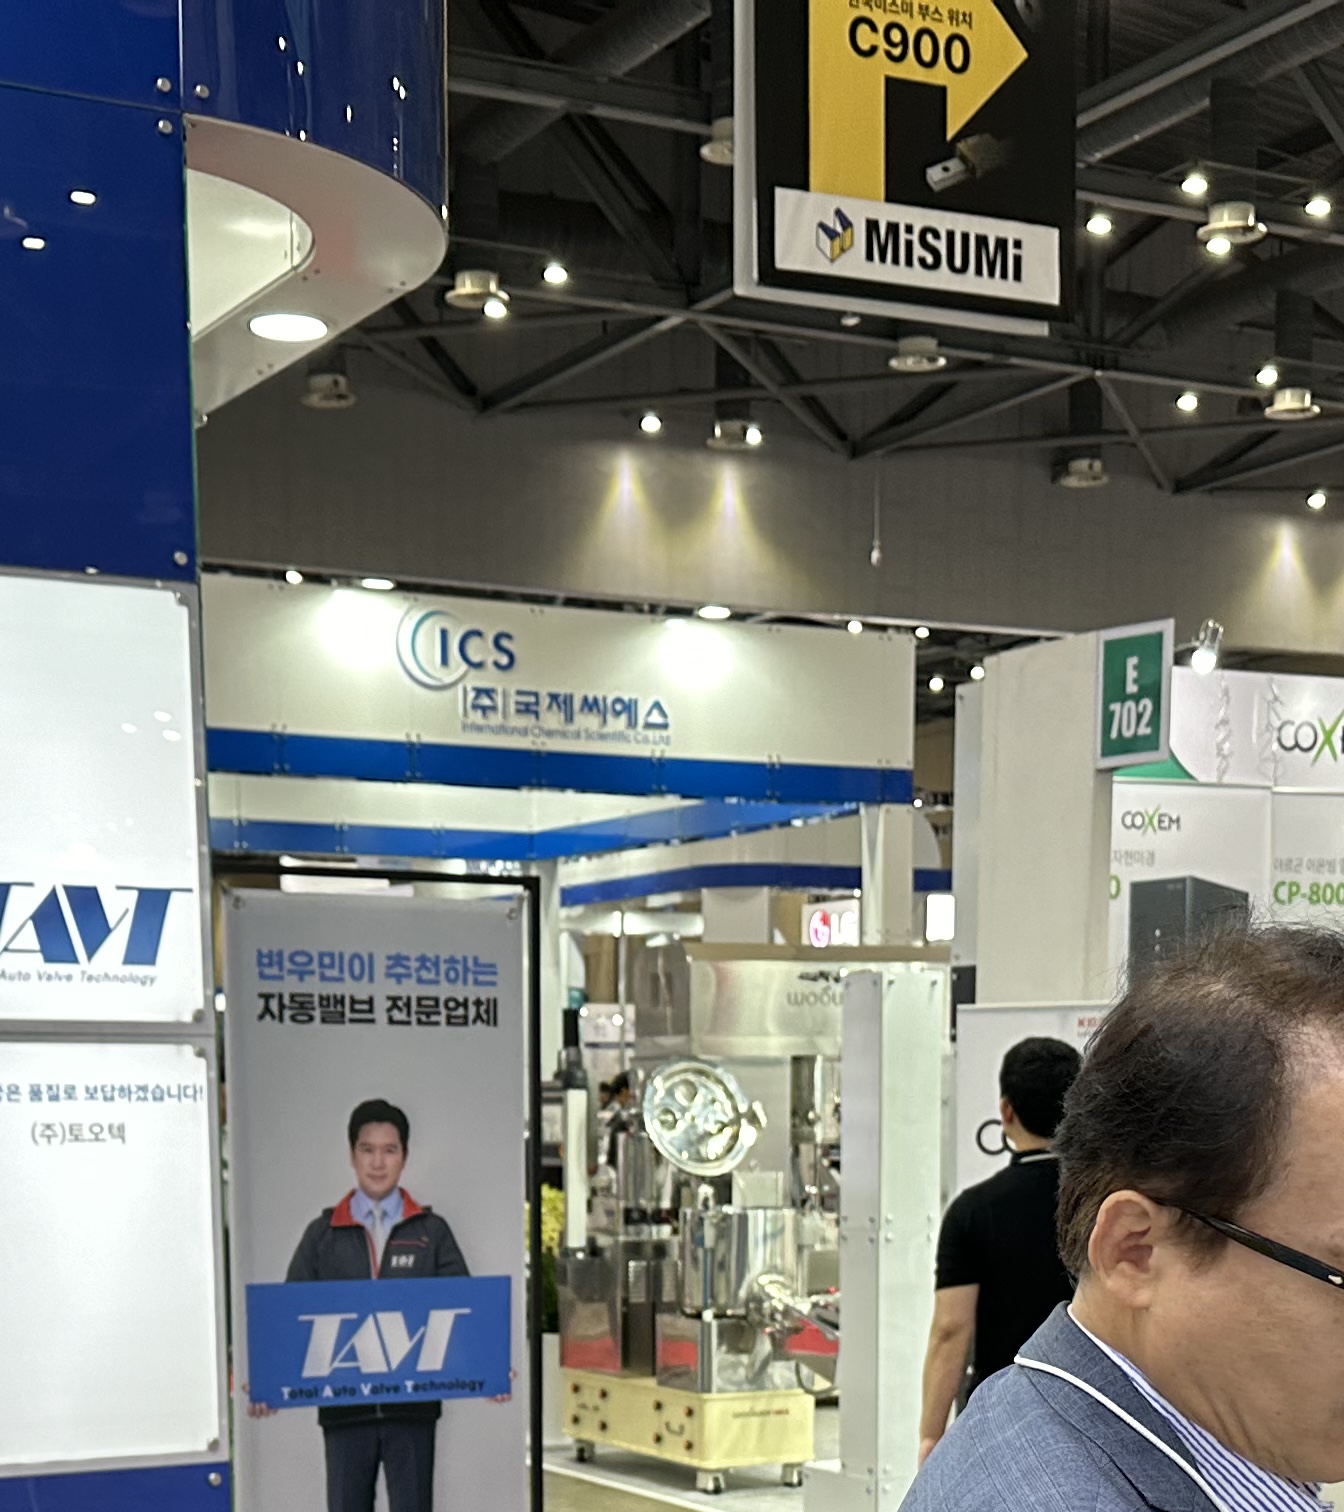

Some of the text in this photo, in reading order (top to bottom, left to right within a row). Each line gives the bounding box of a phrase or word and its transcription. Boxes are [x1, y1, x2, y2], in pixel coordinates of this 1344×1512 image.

[918, 2, 944, 22] 부스
[947, 8, 973, 30] 위치
[848, 15, 971, 74] C900
[440, 627, 516, 670] ICS
[1126, 656, 1139, 694] E
[1109, 699, 1153, 740] 702
[1121, 804, 1181, 836] COXEM
[37, 969, 73, 983] Valve
[80, 970, 157, 986] Technology
[256, 948, 498, 987] 변우민이 추천하는
[256, 992, 498, 1027] 자동밸브 전문업체
[31, 1121, 126, 1145] (주)토오텍
[298, 1308, 472, 1378] TAVT
[281, 1379, 484, 1400] Total Auto Valve Technology
